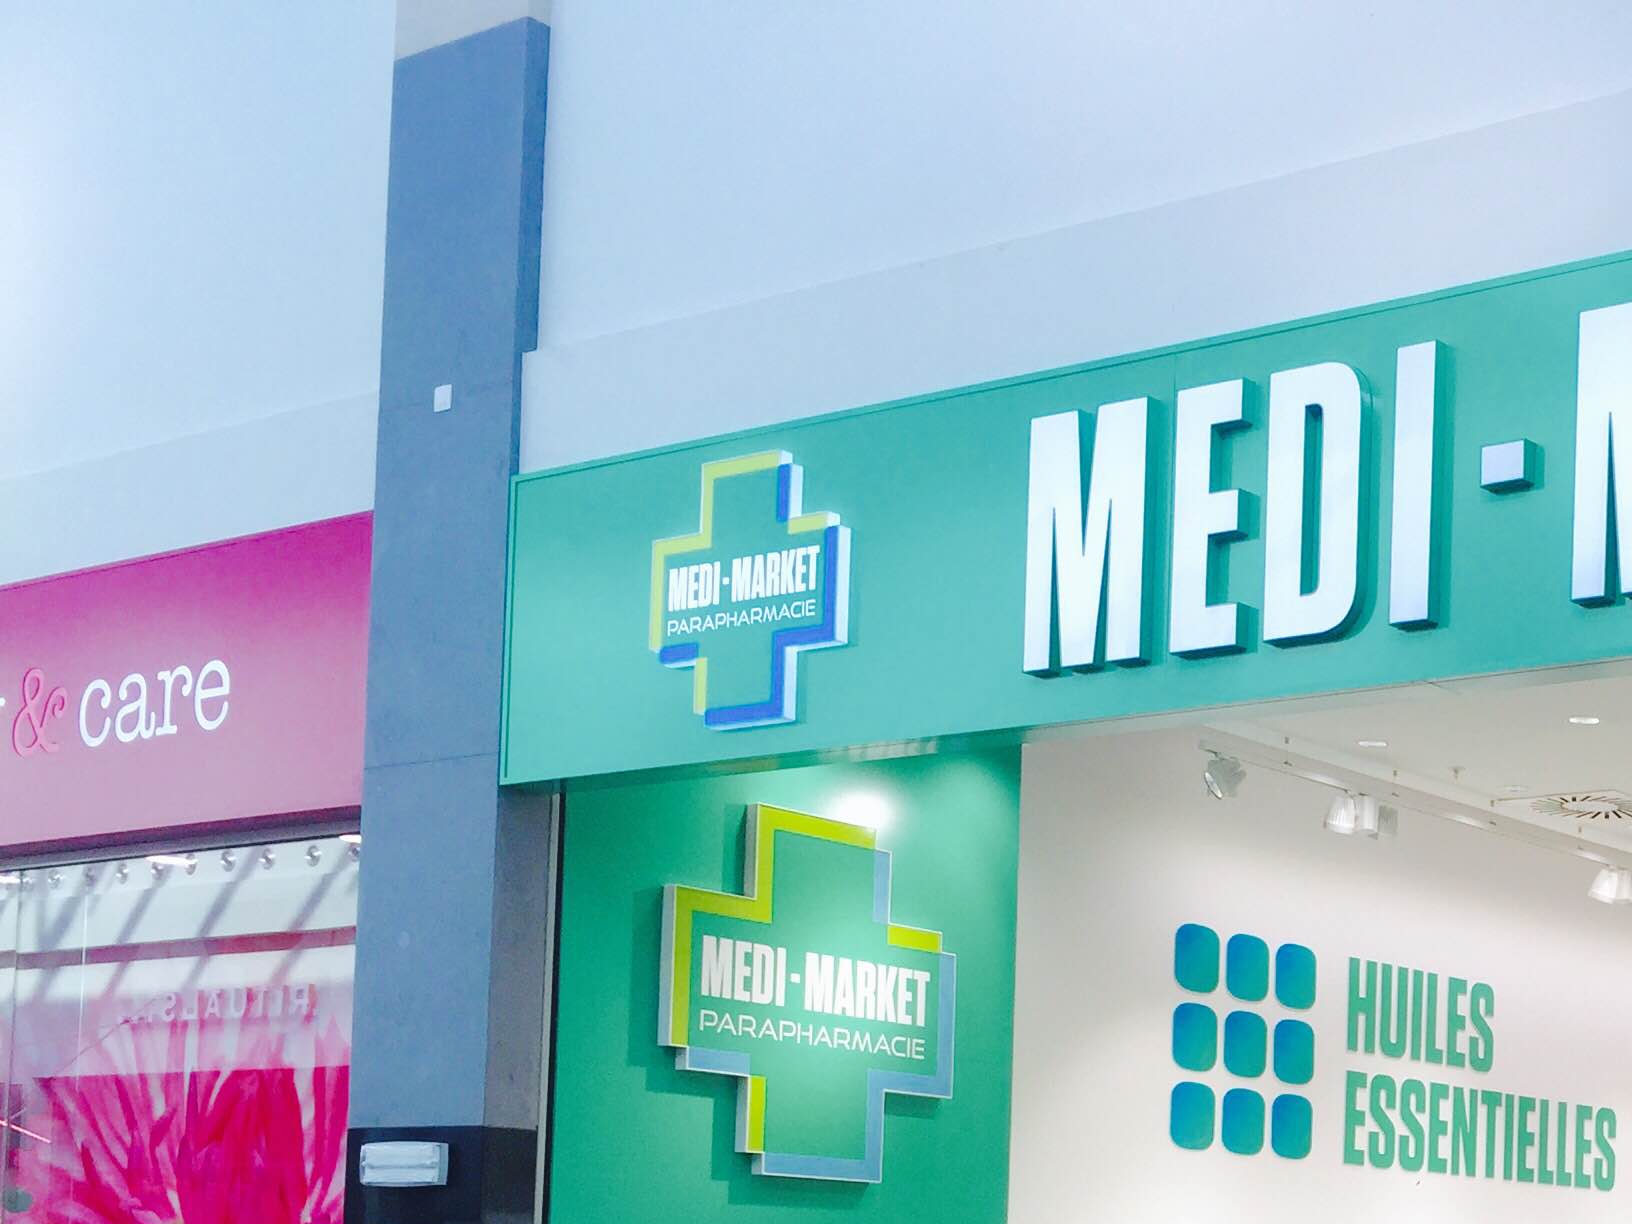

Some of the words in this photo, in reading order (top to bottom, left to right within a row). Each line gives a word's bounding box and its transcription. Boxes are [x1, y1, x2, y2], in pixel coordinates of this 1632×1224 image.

[666, 599, 817, 636] PARAPHARMACIE
[11, 666, 68, 757] &
[79, 657, 231, 748] care
[698, 1009, 926, 1060] PARAPHARMACIE
[1346, 957, 1494, 1073] HUILES
[1343, 1069, 1618, 1192] ESSENTIELLES
